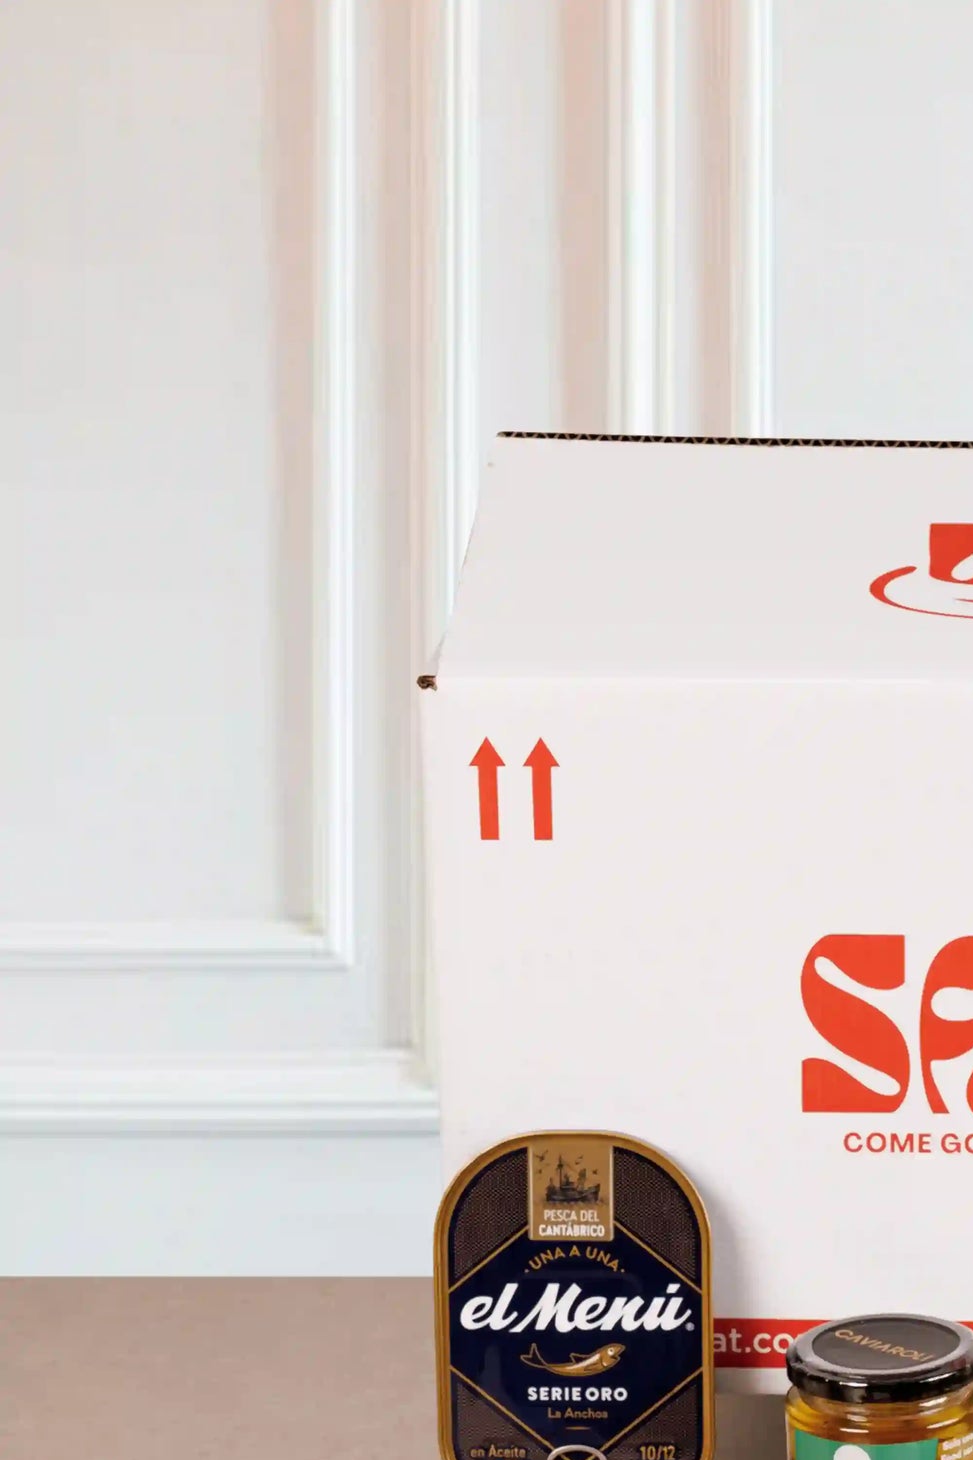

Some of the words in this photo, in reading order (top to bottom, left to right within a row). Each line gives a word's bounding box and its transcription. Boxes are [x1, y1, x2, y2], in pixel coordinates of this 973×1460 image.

[843, 1132, 932, 1153] COME
[543, 1208, 578, 1222] PESCA
[580, 1208, 600, 1222] DEL
[538, 1222, 605, 1237] CANTÁBRICO
[528, 1246, 566, 1270] UNA
[569, 1245, 581, 1257] A
[585, 1246, 620, 1272] UNA
[713, 1328, 801, 1354] at.co
[527, 1386, 582, 1401] SERIE
[585, 1387, 628, 1401] ORO
[547, 1407, 562, 1419] La
[564, 1407, 609, 1419] Anchoa
[470, 1447, 485, 1458] en
[488, 1443, 527, 1458] Aceite
[639, 1445, 676, 1460] 10/12
